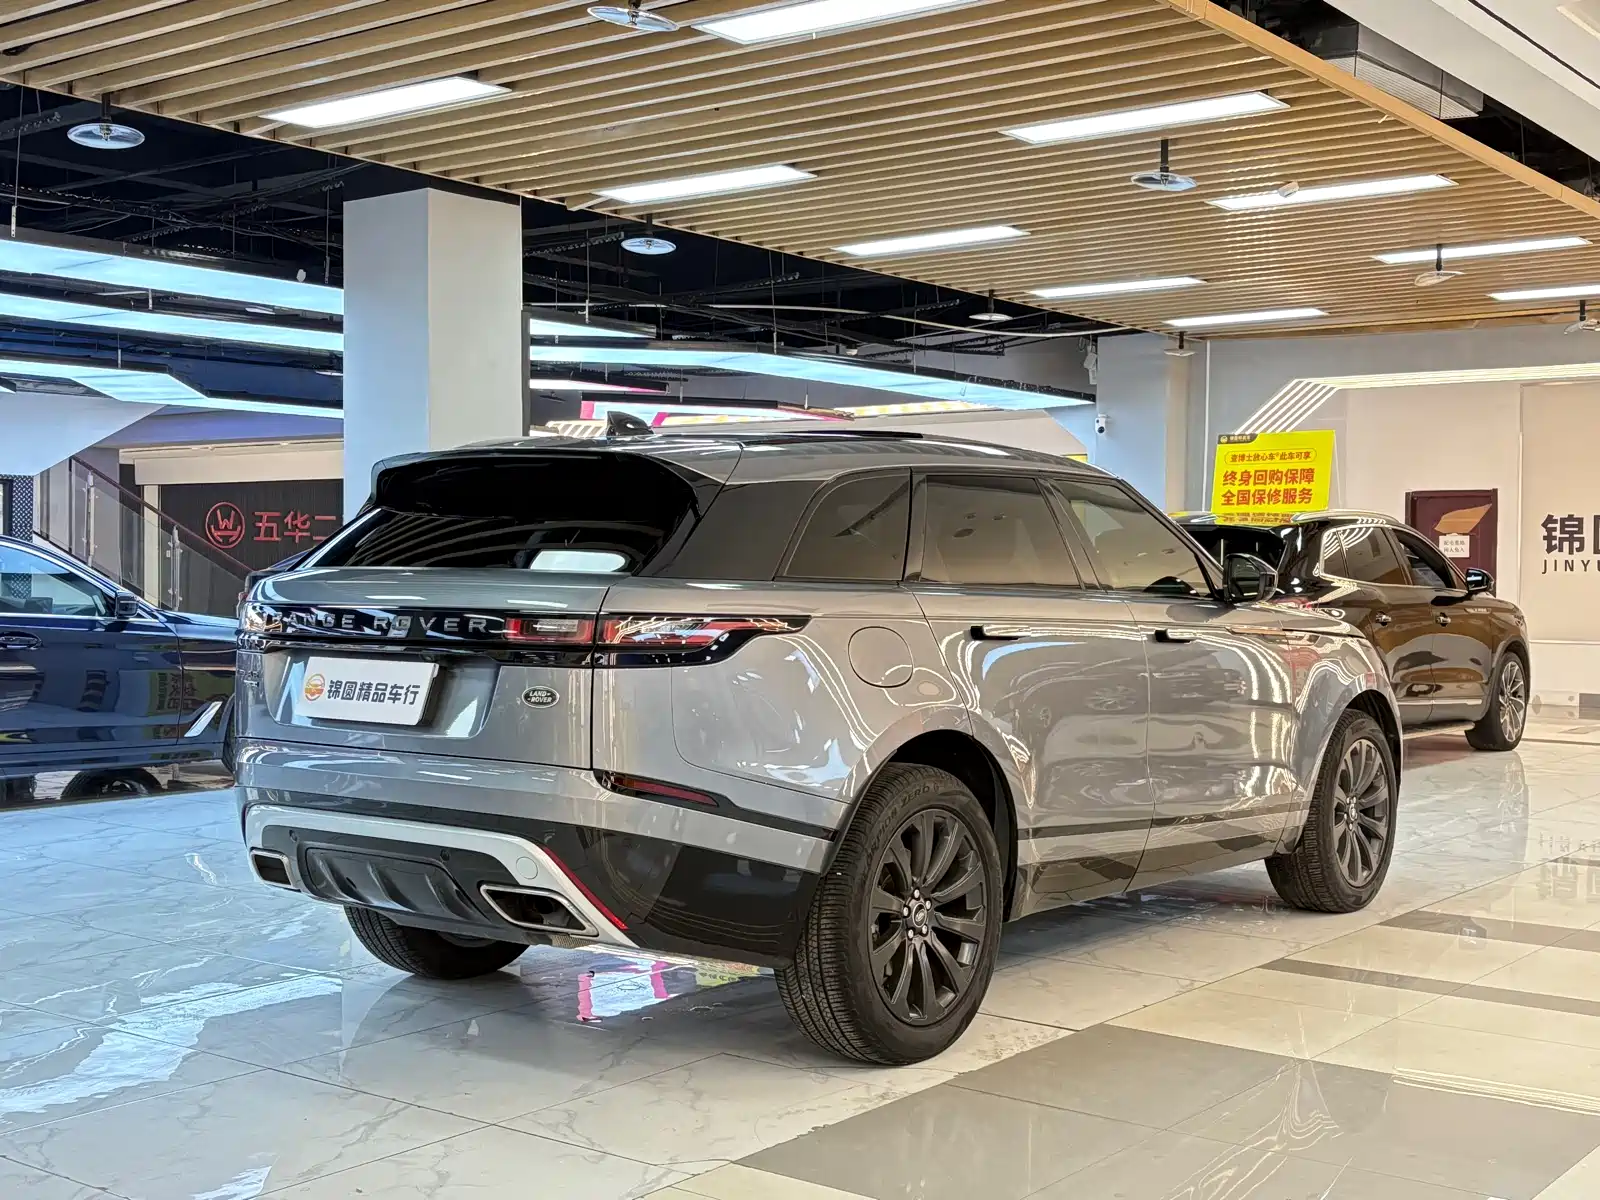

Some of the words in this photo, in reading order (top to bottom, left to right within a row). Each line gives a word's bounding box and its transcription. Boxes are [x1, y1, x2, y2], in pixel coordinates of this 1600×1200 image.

[1222, 467, 1315, 487] 终身回购保障
[1221, 487, 1313, 506] 全国保修服务
[1541, 514, 1600, 555] 锦
[373, 615, 487, 633] ROVER
[327, 679, 421, 705] 锦圆精品车行
